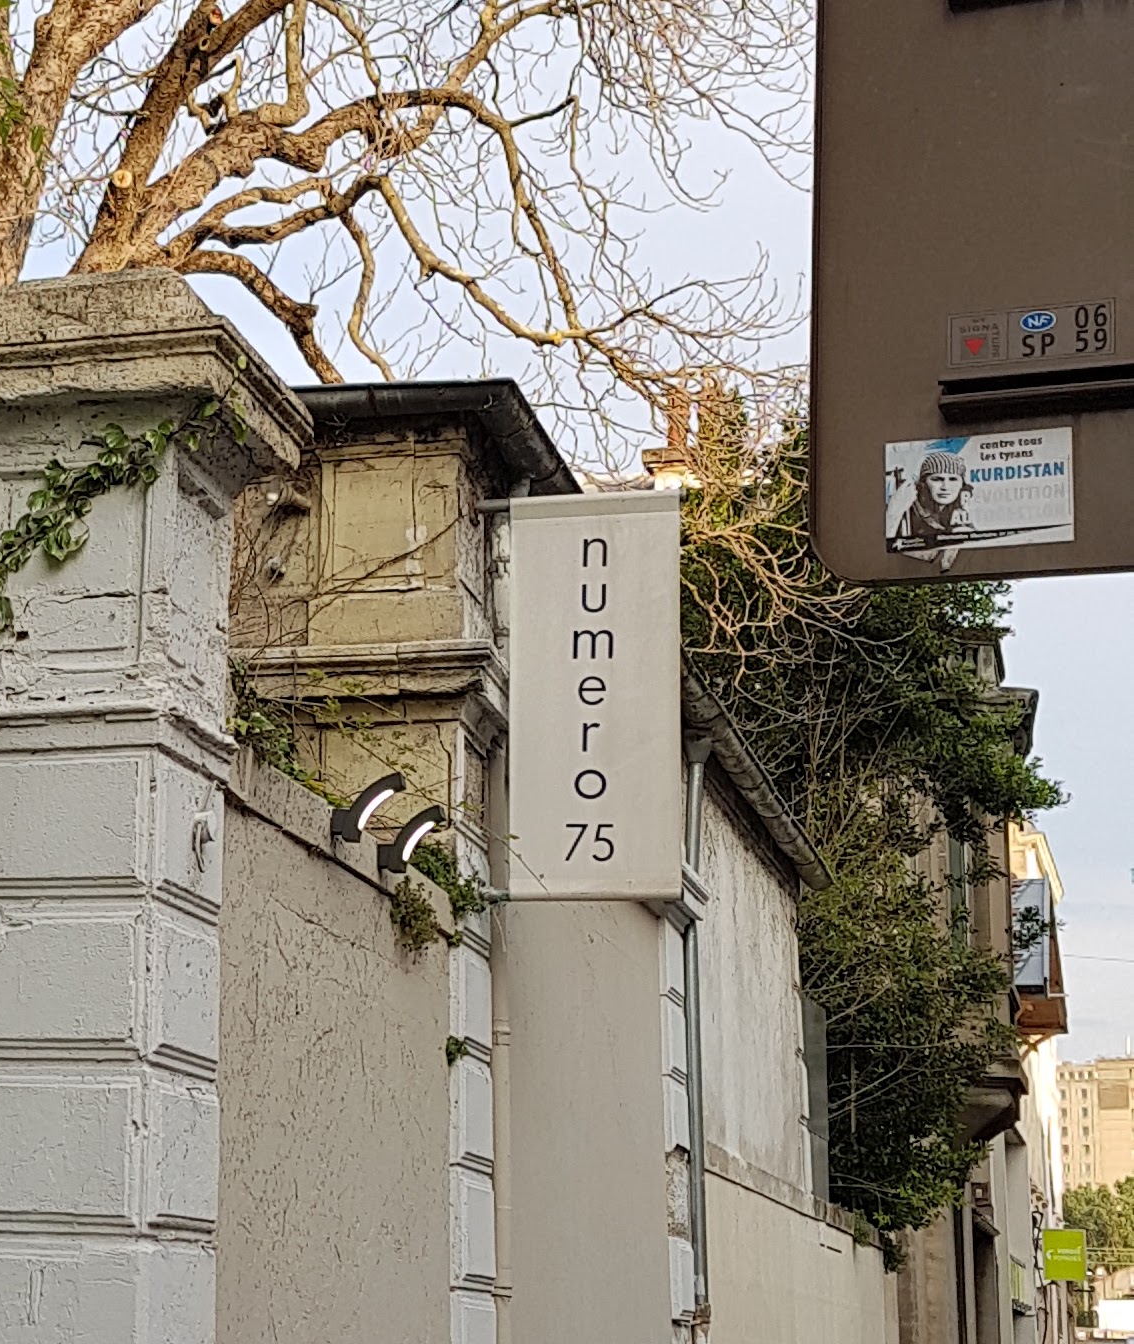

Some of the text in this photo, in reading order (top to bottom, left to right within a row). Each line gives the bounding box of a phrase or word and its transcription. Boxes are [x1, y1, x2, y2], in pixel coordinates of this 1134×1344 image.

[1027, 305, 1108, 329] NF 06
[1022, 328, 1108, 357] SP 59
[979, 437, 1043, 450] contre tous
[980, 449, 1034, 462] les tyrans
[970, 461, 1065, 483] KURDISTAN
[572, 538, 614, 800] numero
[564, 823, 615, 862] 75
